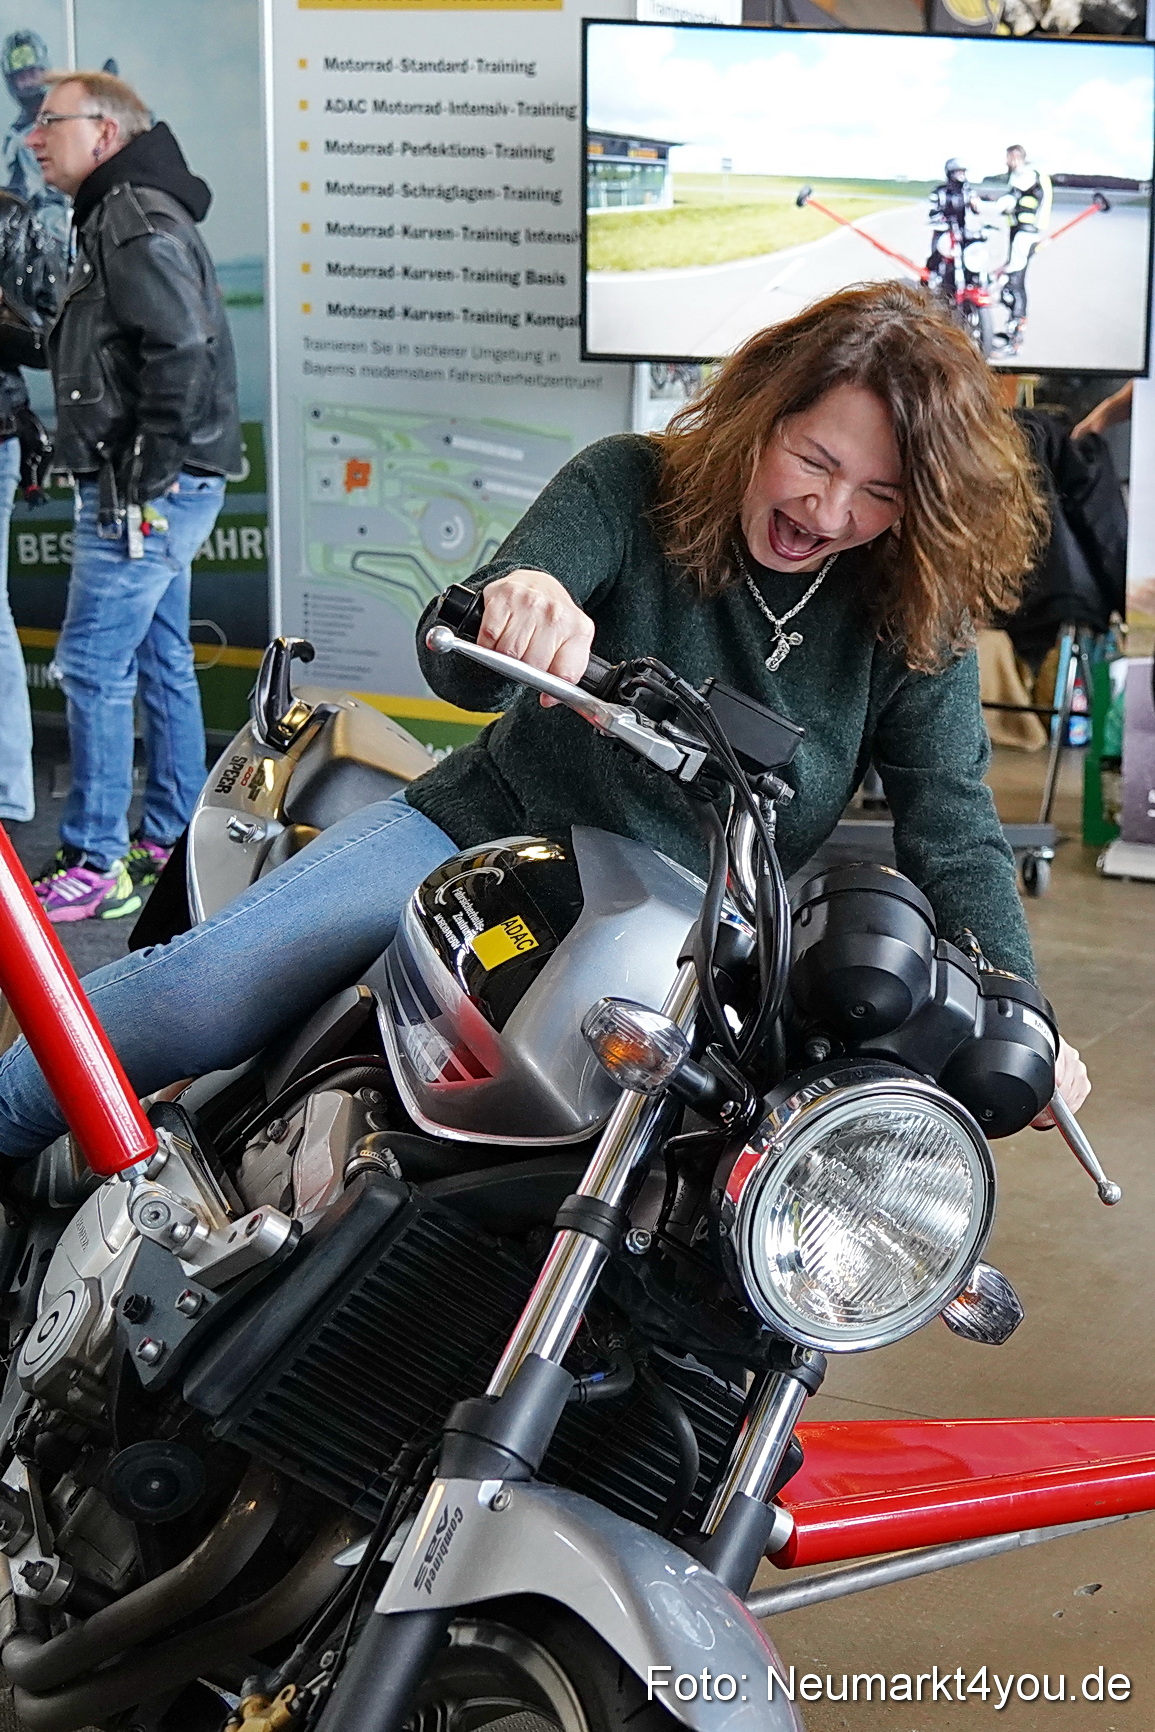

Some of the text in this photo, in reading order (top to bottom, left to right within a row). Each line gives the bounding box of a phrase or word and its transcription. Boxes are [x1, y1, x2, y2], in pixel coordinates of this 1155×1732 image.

[324, 57, 536, 78] Motorrad-Standard-Training
[325, 99, 578, 121] ADAC Motorrad-Intensiv-Training
[325, 141, 555, 163] Motorrad-Perfektions-Training
[326, 181, 562, 205] Motorrad-Schräglagen-Training
[326, 222, 519, 246] Motorrad-Kurven-Training
[327, 262, 567, 287] Motorrad-Kurven-Training Basis
[328, 303, 519, 328] Motorrad-Kurven-Training
[500, 919, 534, 951] ADAC
[424, 1506, 464, 1594] Combined
